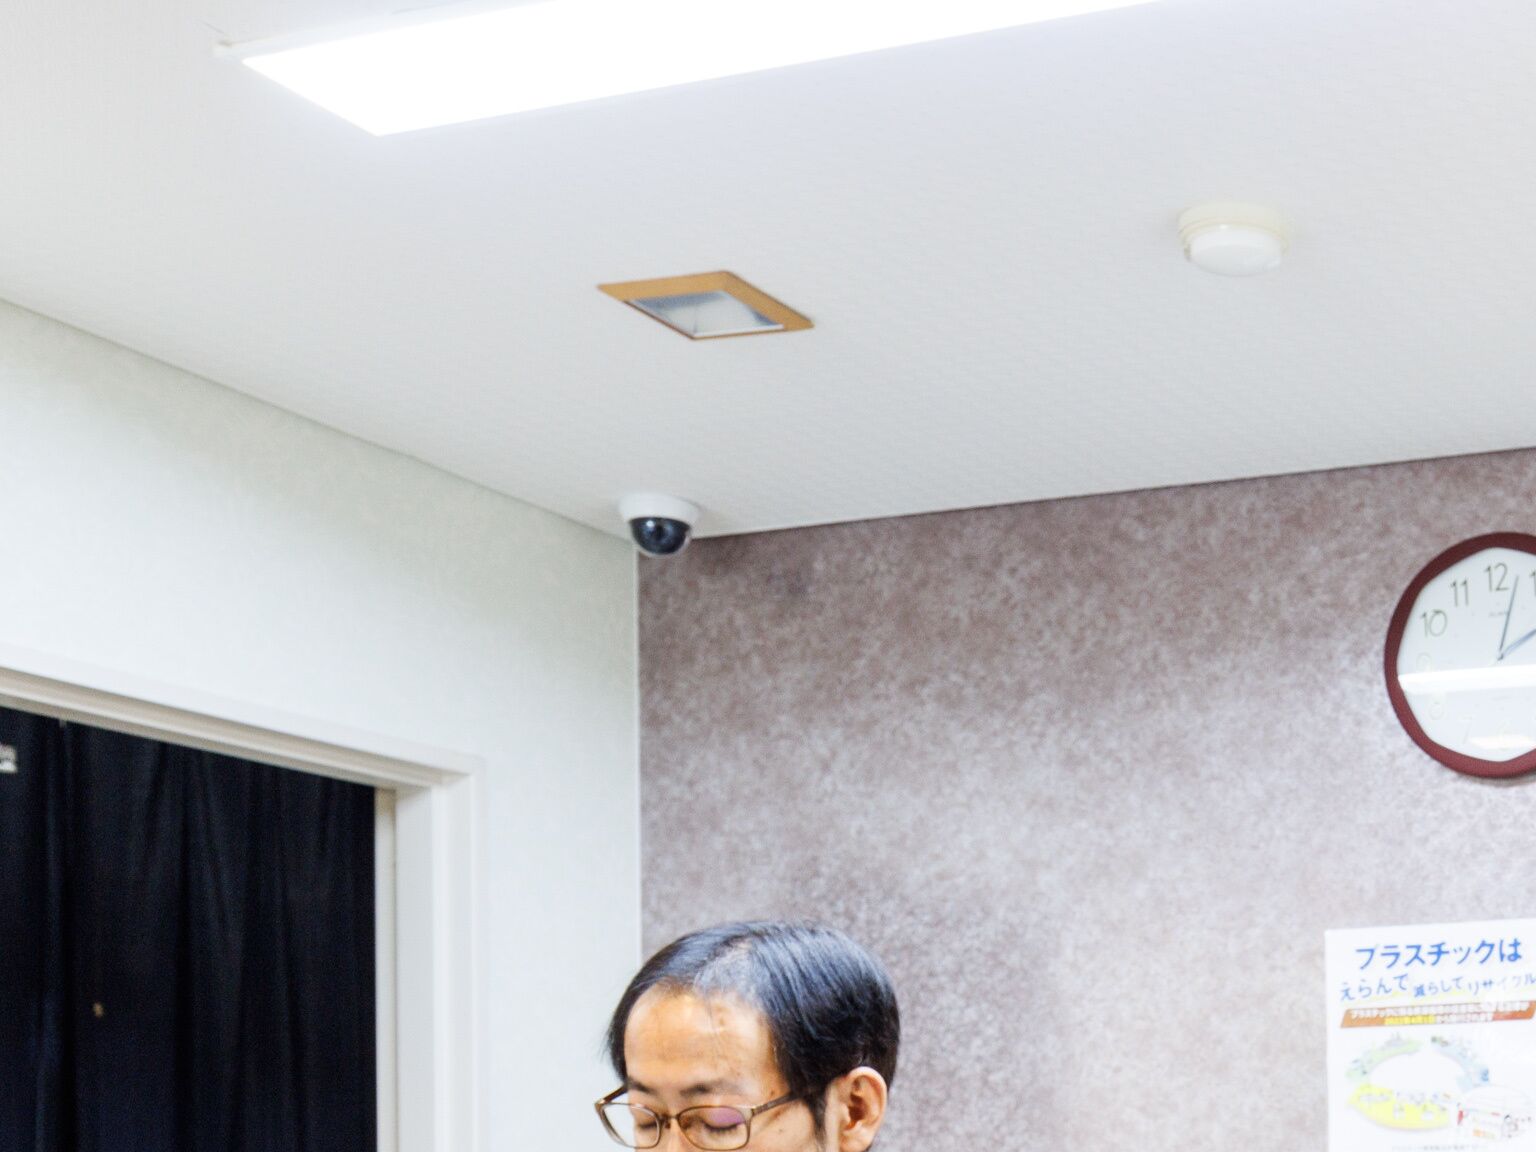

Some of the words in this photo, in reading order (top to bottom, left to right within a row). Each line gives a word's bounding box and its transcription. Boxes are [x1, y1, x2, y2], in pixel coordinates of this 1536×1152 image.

[1484, 563, 1509, 592] 12
[1450, 579, 1469, 607] 11
[1420, 609, 1449, 638] 10
[1355, 937, 1523, 970] プラスチックは
